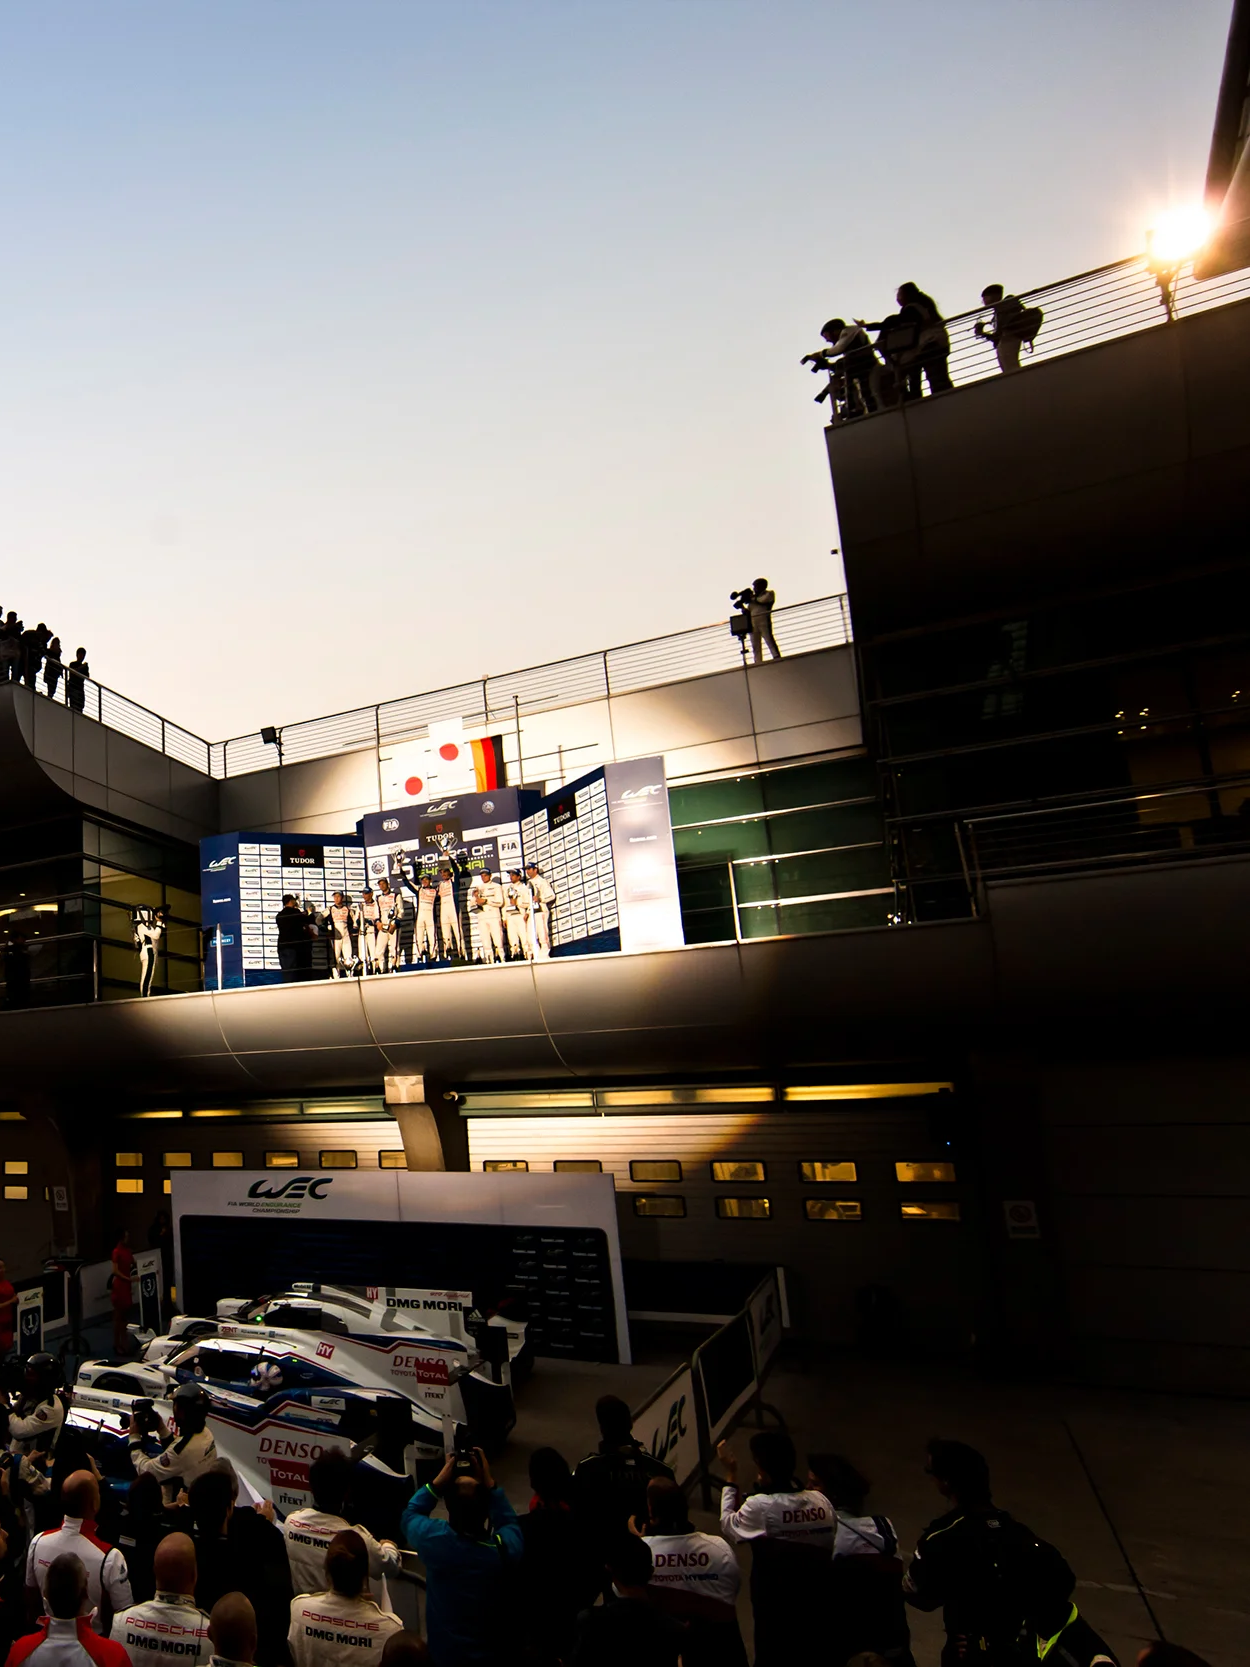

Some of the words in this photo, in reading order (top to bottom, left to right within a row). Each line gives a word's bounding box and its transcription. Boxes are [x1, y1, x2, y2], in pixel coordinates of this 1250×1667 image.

[427, 800, 458, 813] WEC
[553, 811, 571, 825] TUDOR
[383, 820, 399, 831] FIA
[426, 832, 454, 843] TUDOR
[472, 843, 493, 856] OF
[501, 841, 519, 852] FIA
[208, 856, 237, 869] WEC
[248, 1177, 333, 1200] WEC
[146, 1280, 152, 1291] 3
[366, 1286, 379, 1300] HY
[386, 1298, 420, 1309] DMG
[423, 1299, 463, 1312] MORI
[28, 1314, 34, 1329] 1
[318, 1343, 334, 1358] HY
[391, 1369, 417, 1378] TOYOTA
[417, 1369, 448, 1380] TOTAL
[424, 1391, 444, 1399] JTEKT
[259, 1437, 324, 1460] DENSO
[271, 1468, 310, 1484] TOTAL
[279, 1493, 303, 1506] JTEKT
[782, 1507, 826, 1524] DENSO
[288, 1531, 311, 1545] DMG
[655, 1552, 709, 1568] DENSO
[654, 1574, 683, 1582] TOYOTA
[125, 1617, 208, 1638] PORSCHE
[301, 1610, 379, 1632] PORSCHE
[305, 1626, 333, 1642] DMG
[336, 1633, 372, 1648] MORI
[126, 1633, 158, 1651] DMG
[161, 1640, 200, 1657] MORI
